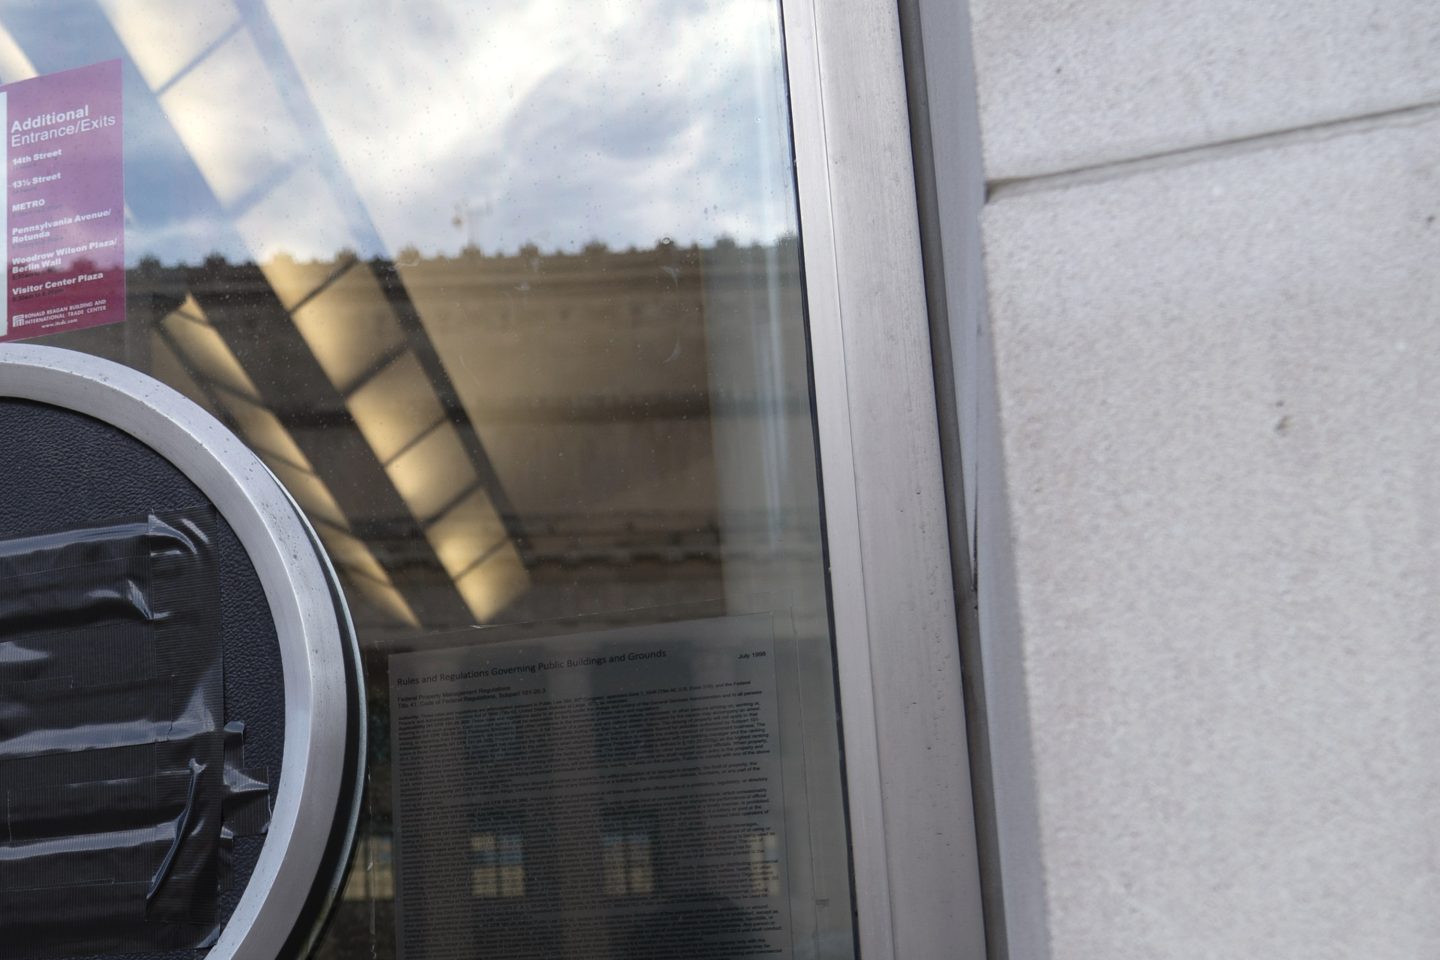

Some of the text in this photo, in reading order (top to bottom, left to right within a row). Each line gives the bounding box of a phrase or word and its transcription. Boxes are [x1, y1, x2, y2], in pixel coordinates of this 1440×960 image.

[11, 104, 89, 133] Additional
[11, 115, 116, 147] Entrance/Exits
[12, 155, 32, 166] 14th
[33, 149, 63, 161] Street
[32, 172, 62, 185] Street
[12, 198, 46, 212] METRO
[12, 217, 73, 235] Pennsylvania
[12, 231, 51, 244] Rotunda
[12, 251, 55, 265] Woodrow
[56, 245, 88, 257] Wilson
[12, 257, 62, 274] Berlin Wall
[12, 284, 44, 295] Visitor
[45, 277, 77, 289] Center
[78, 272, 104, 283] Plaza
[397, 649, 667, 687] Rules and Regulations Governing Public Buildings and Grounds
